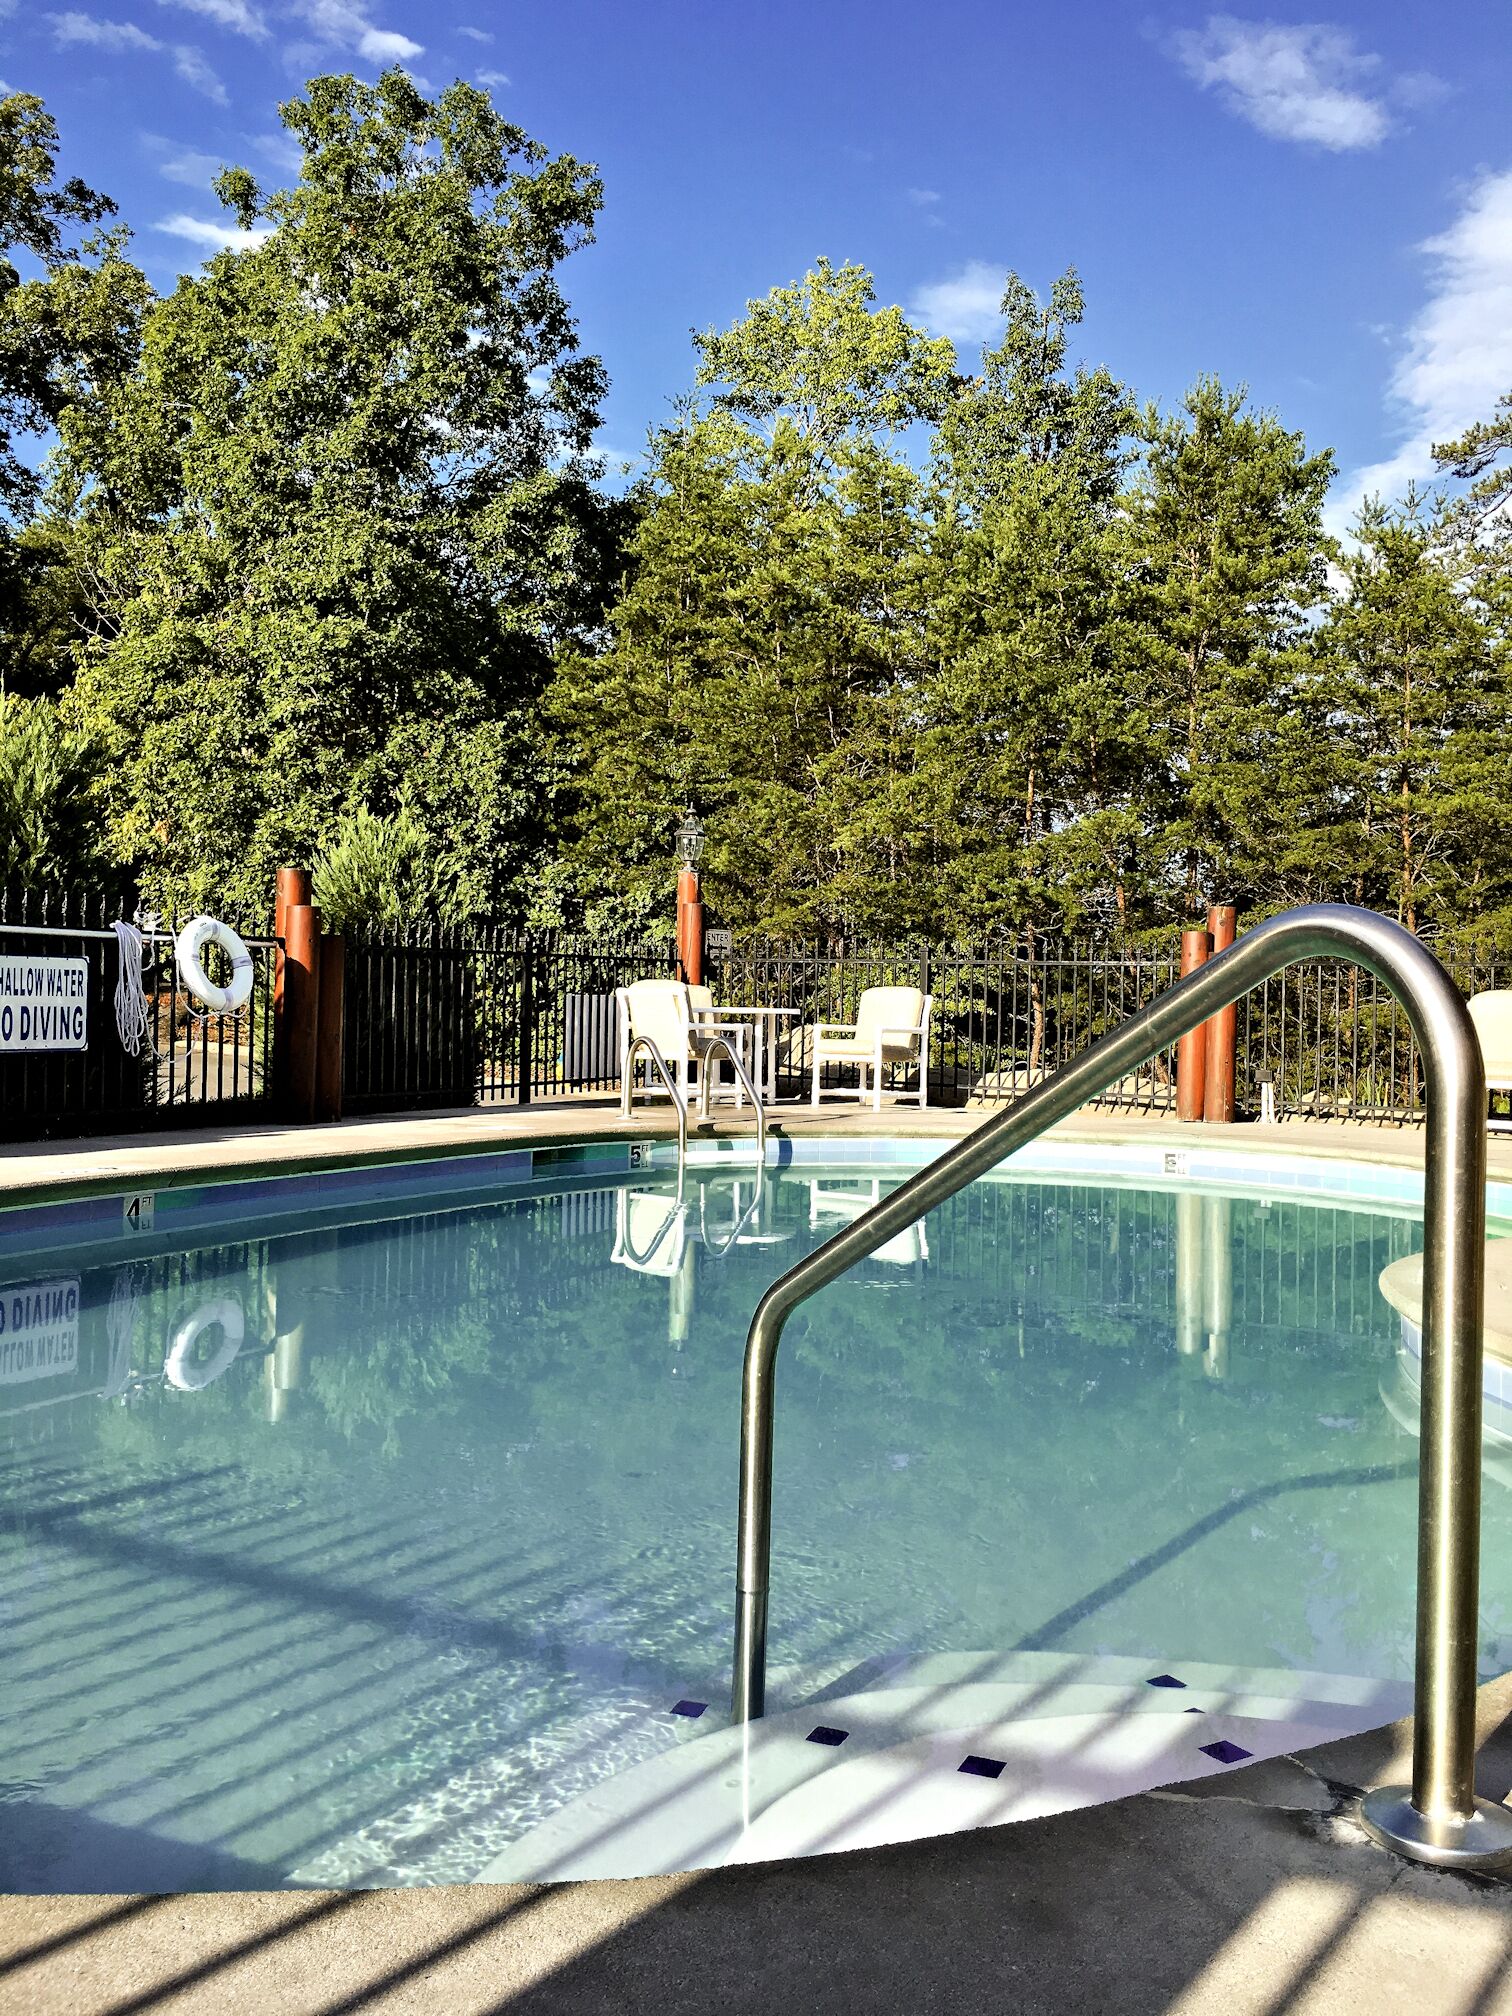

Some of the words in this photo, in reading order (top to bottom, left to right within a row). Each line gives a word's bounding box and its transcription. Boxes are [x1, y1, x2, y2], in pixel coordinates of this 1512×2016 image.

[47, 968, 84, 997] WATER
[20, 1005, 83, 1041] DIVING
[126, 1197, 140, 1217] 4
[142, 1196, 152, 1204] FT
